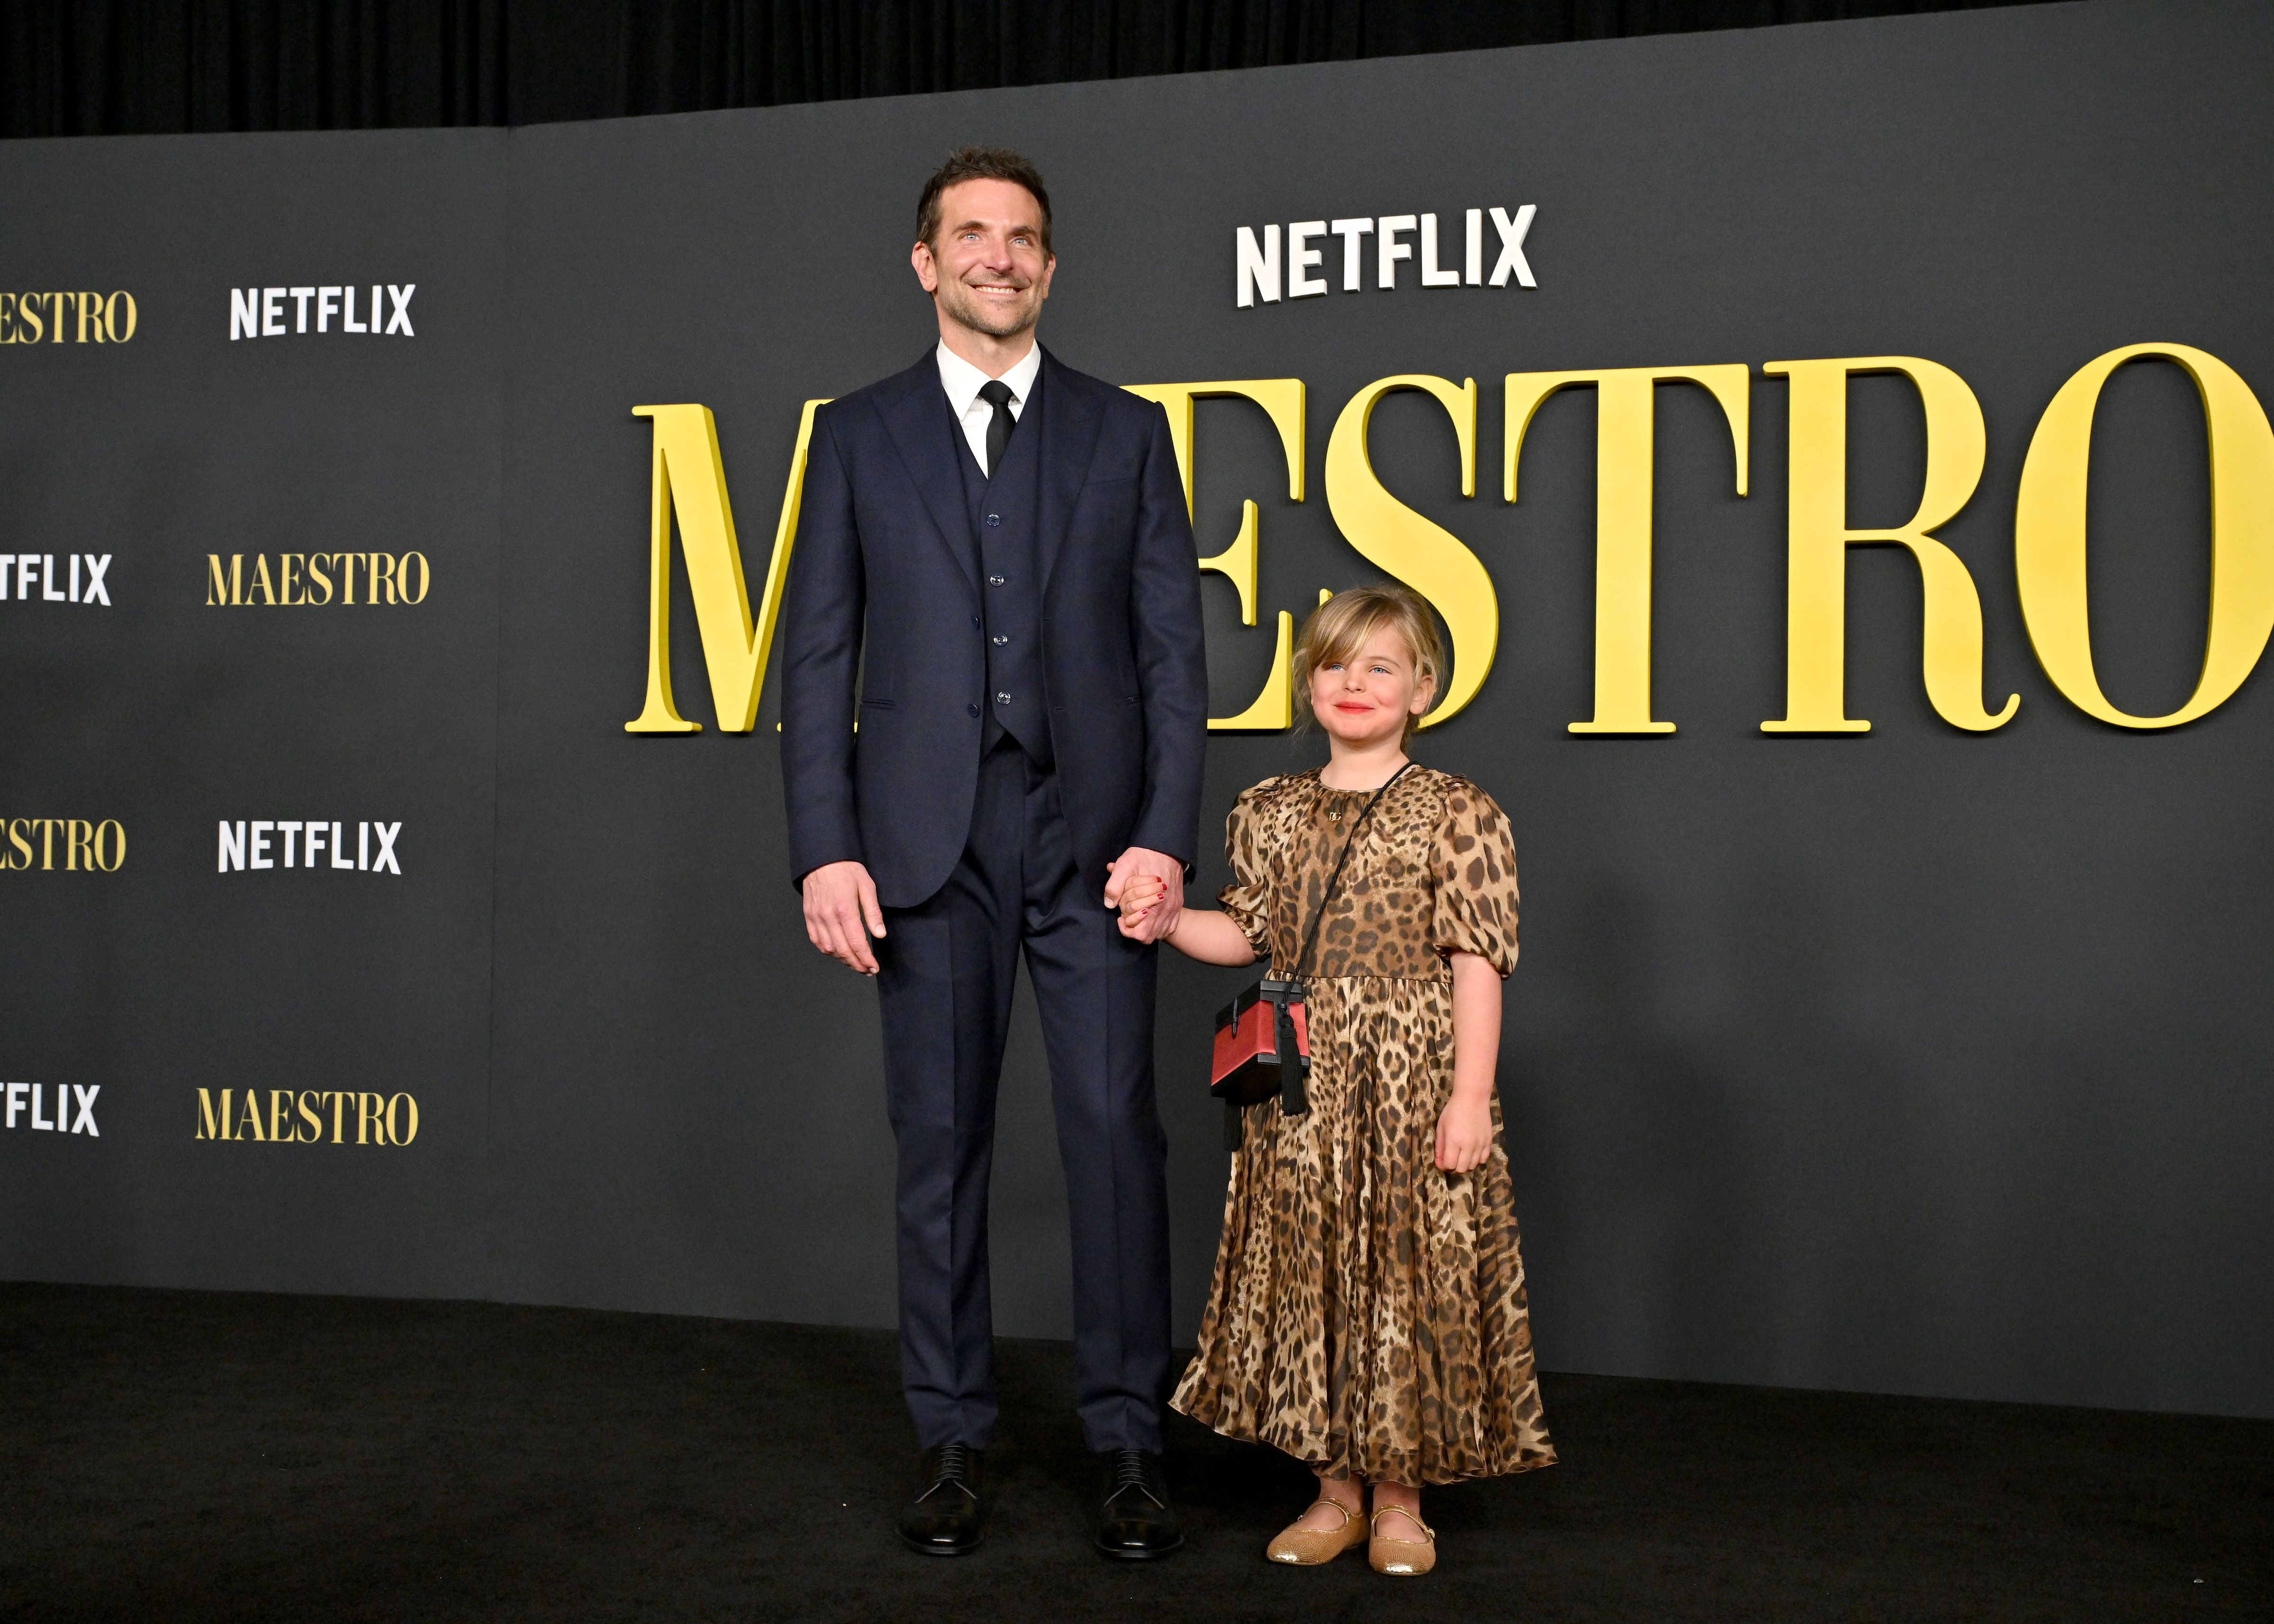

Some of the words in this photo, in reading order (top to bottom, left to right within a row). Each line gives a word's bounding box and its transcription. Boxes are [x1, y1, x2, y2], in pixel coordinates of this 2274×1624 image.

[1236, 204, 1538, 309] NETFLIX
[0, 290, 137, 344] ESTRO
[230, 284, 416, 341] NETFLIX
[624, 342, 2274, 734] MESTRO
[206, 551, 430, 606] MAESTRO
[0, 818, 126, 872] STRO
[218, 820, 402, 875] NETFLIX
[0, 1082, 101, 1137] FLIX
[195, 1088, 419, 1146] MAESTRO
